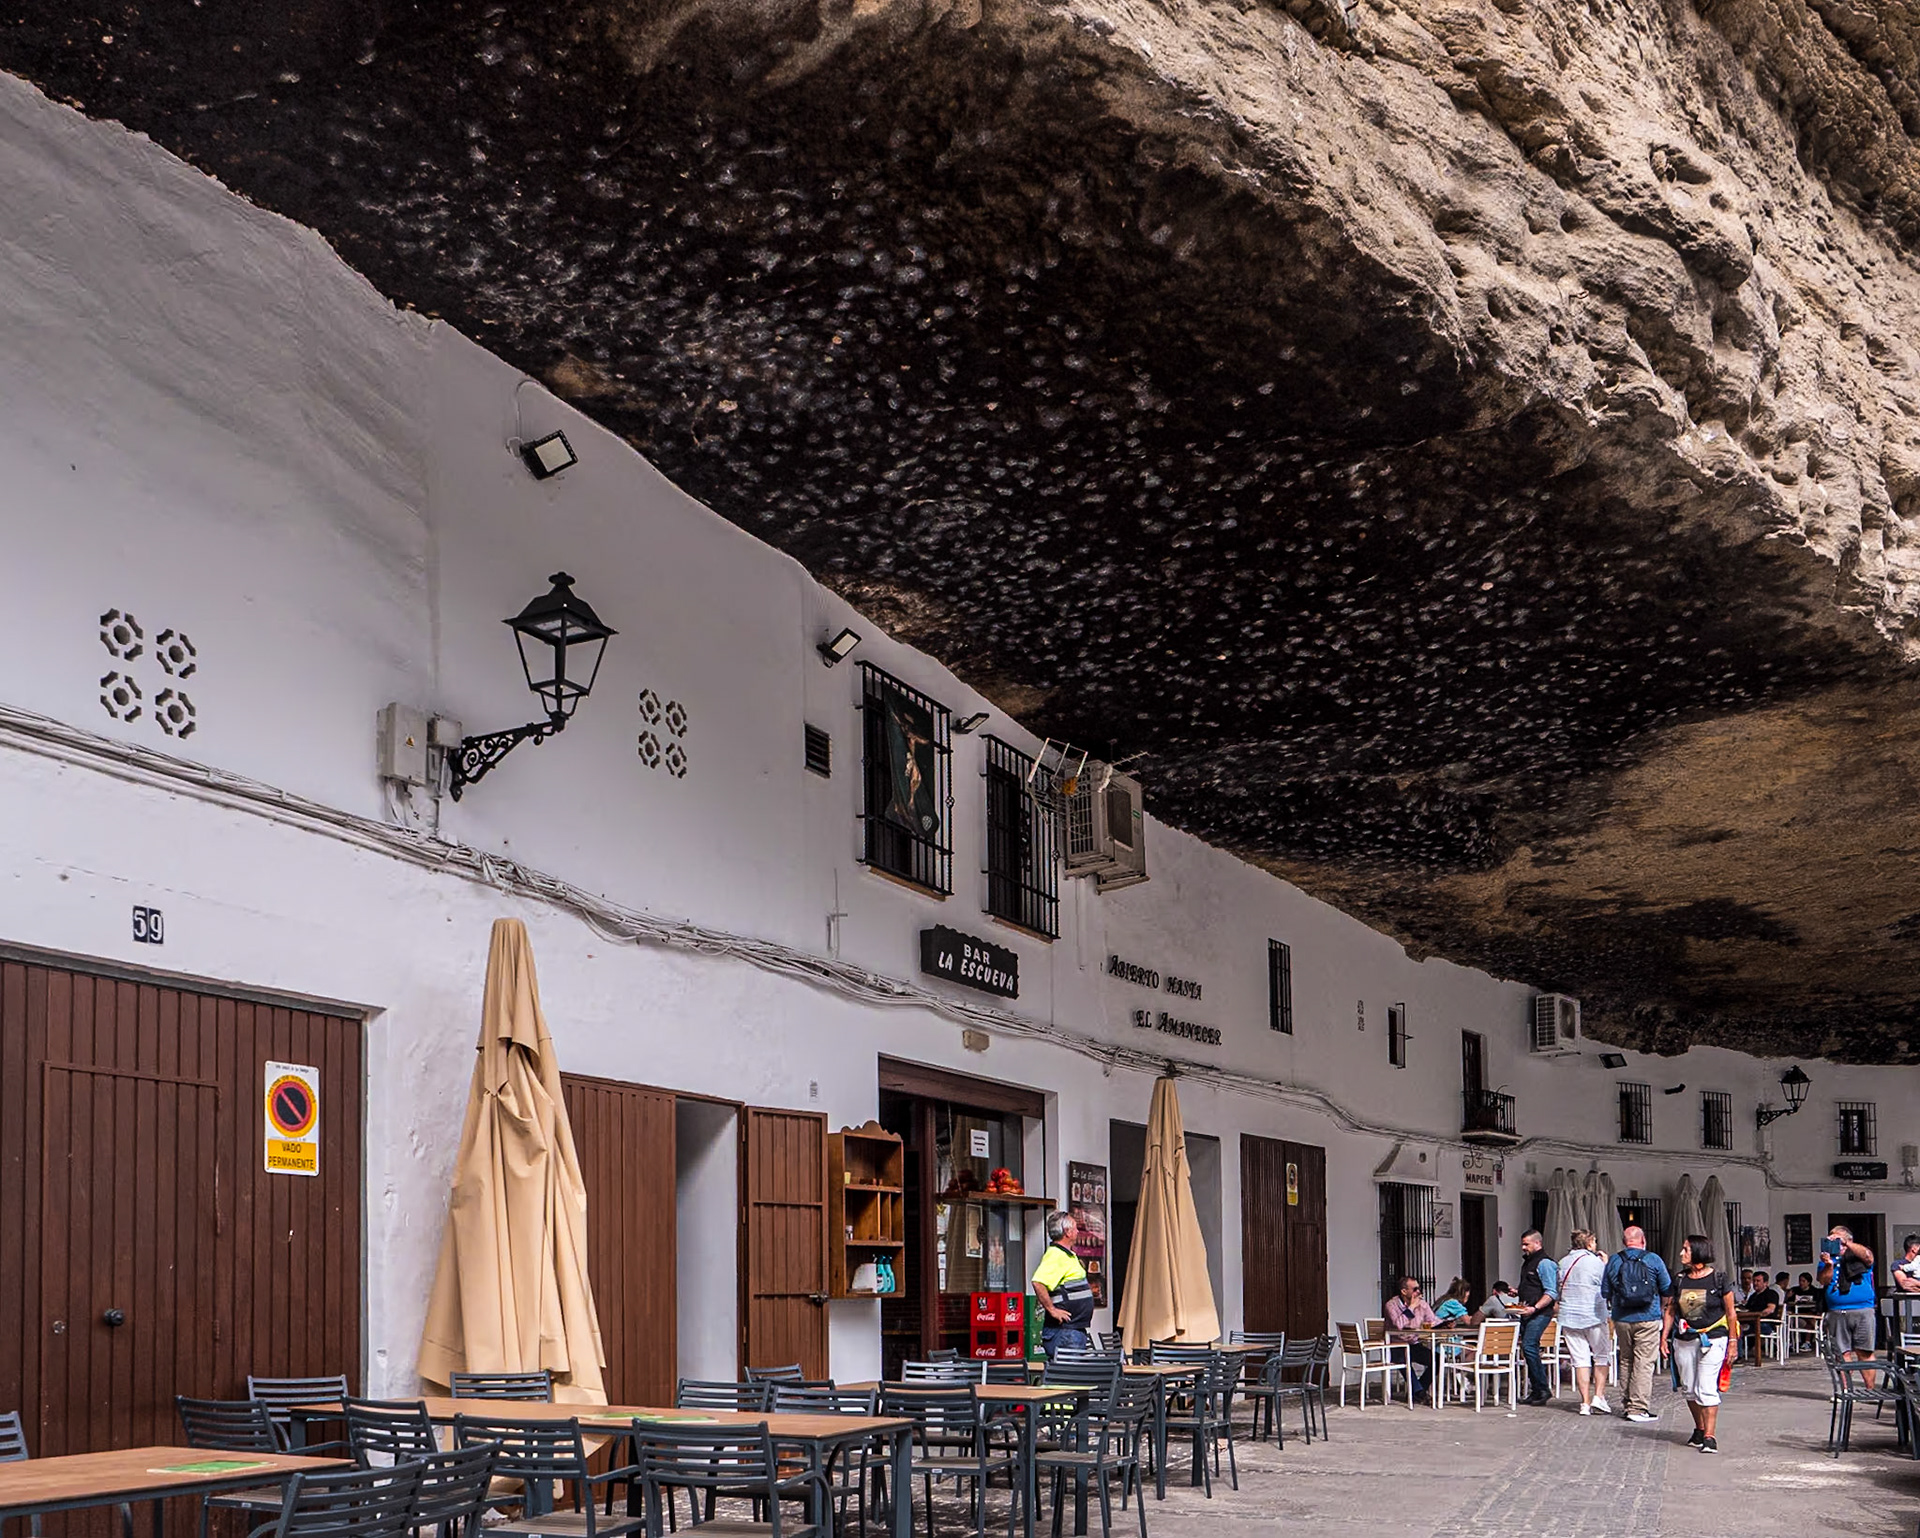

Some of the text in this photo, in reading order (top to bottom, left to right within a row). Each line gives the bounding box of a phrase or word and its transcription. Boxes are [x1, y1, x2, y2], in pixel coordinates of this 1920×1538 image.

[134, 909, 163, 941] 59
[963, 943, 990, 965] BAR
[938, 951, 1014, 991] LA ESCUEVA
[1135, 1010, 1152, 1028] EL
[282, 1143, 302, 1153] VADO
[268, 1156, 314, 1169] PERMANENTE
[1465, 1173, 1493, 1185] MAPFRE
